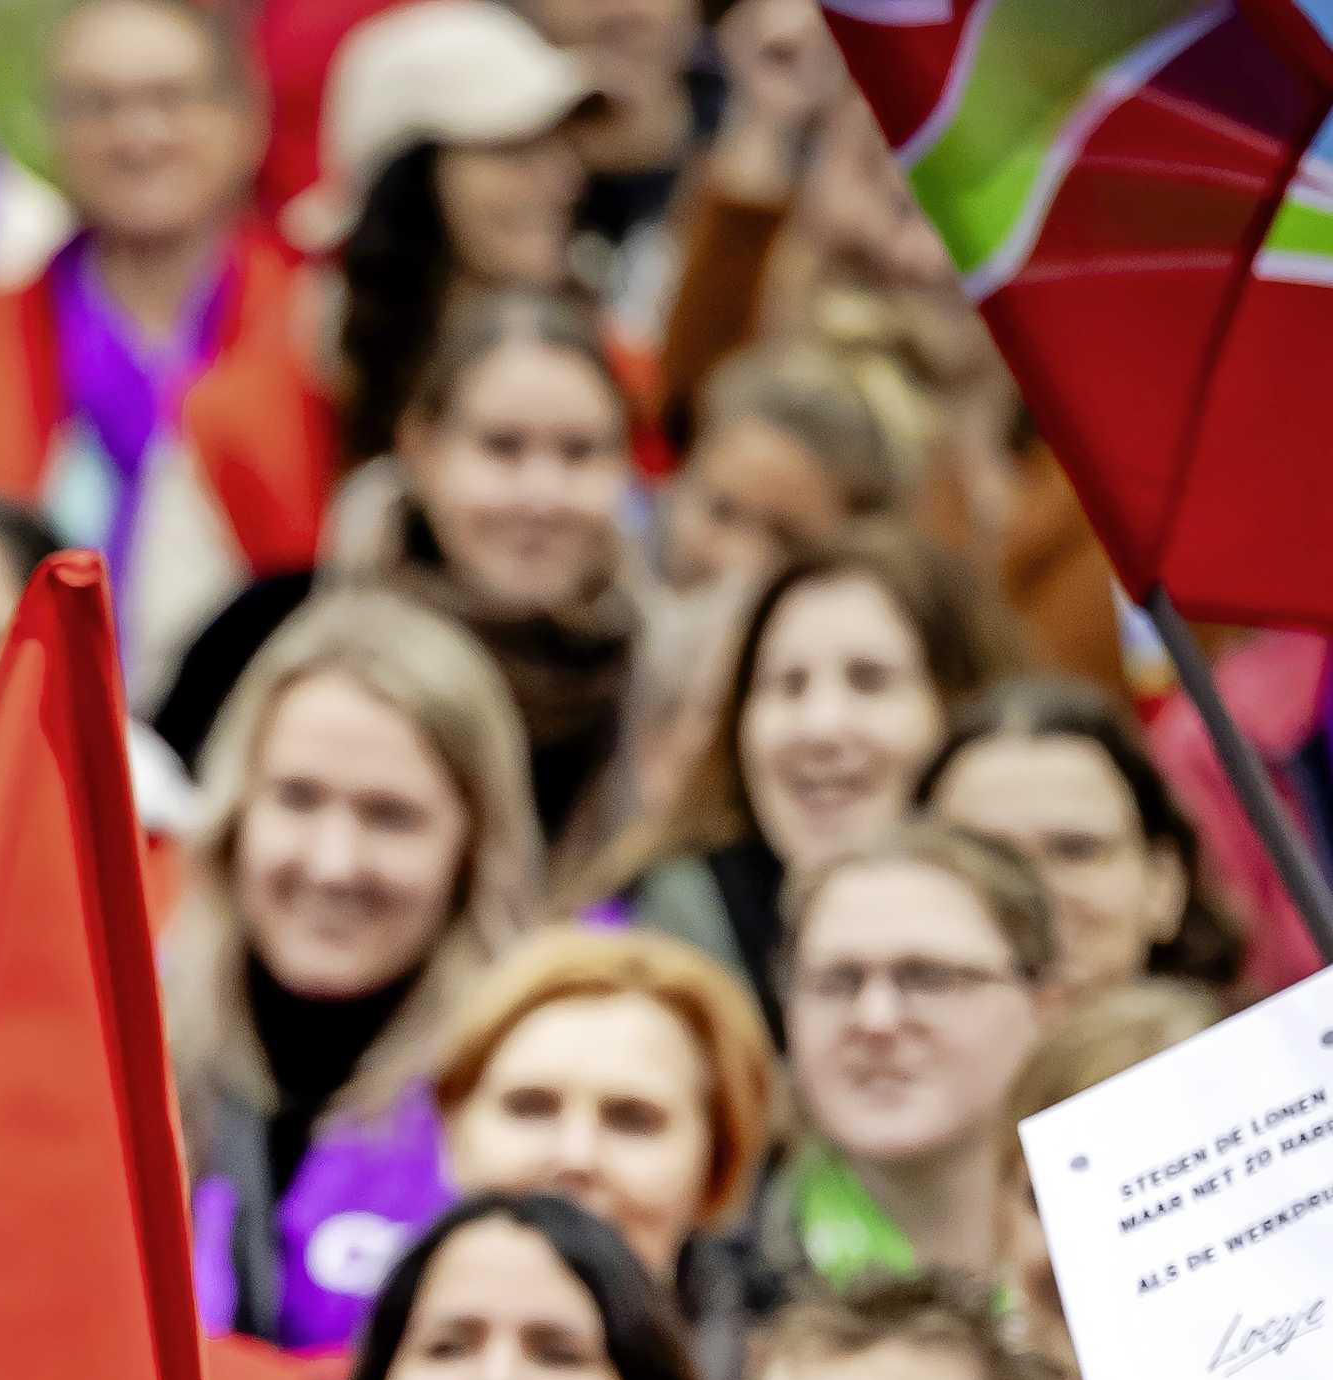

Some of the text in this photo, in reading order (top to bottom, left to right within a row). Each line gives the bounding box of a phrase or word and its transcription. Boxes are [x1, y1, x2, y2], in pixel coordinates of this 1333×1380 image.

[1119, 1195, 1184, 1235] MAAR
[1192, 1168, 1234, 1201] NET
[1244, 1149, 1272, 1176] ZO
[1120, 1088, 1326, 1200] STEGEN DE LONEN
[1138, 1184, 1333, 1296] ALS DE WERKDRU
